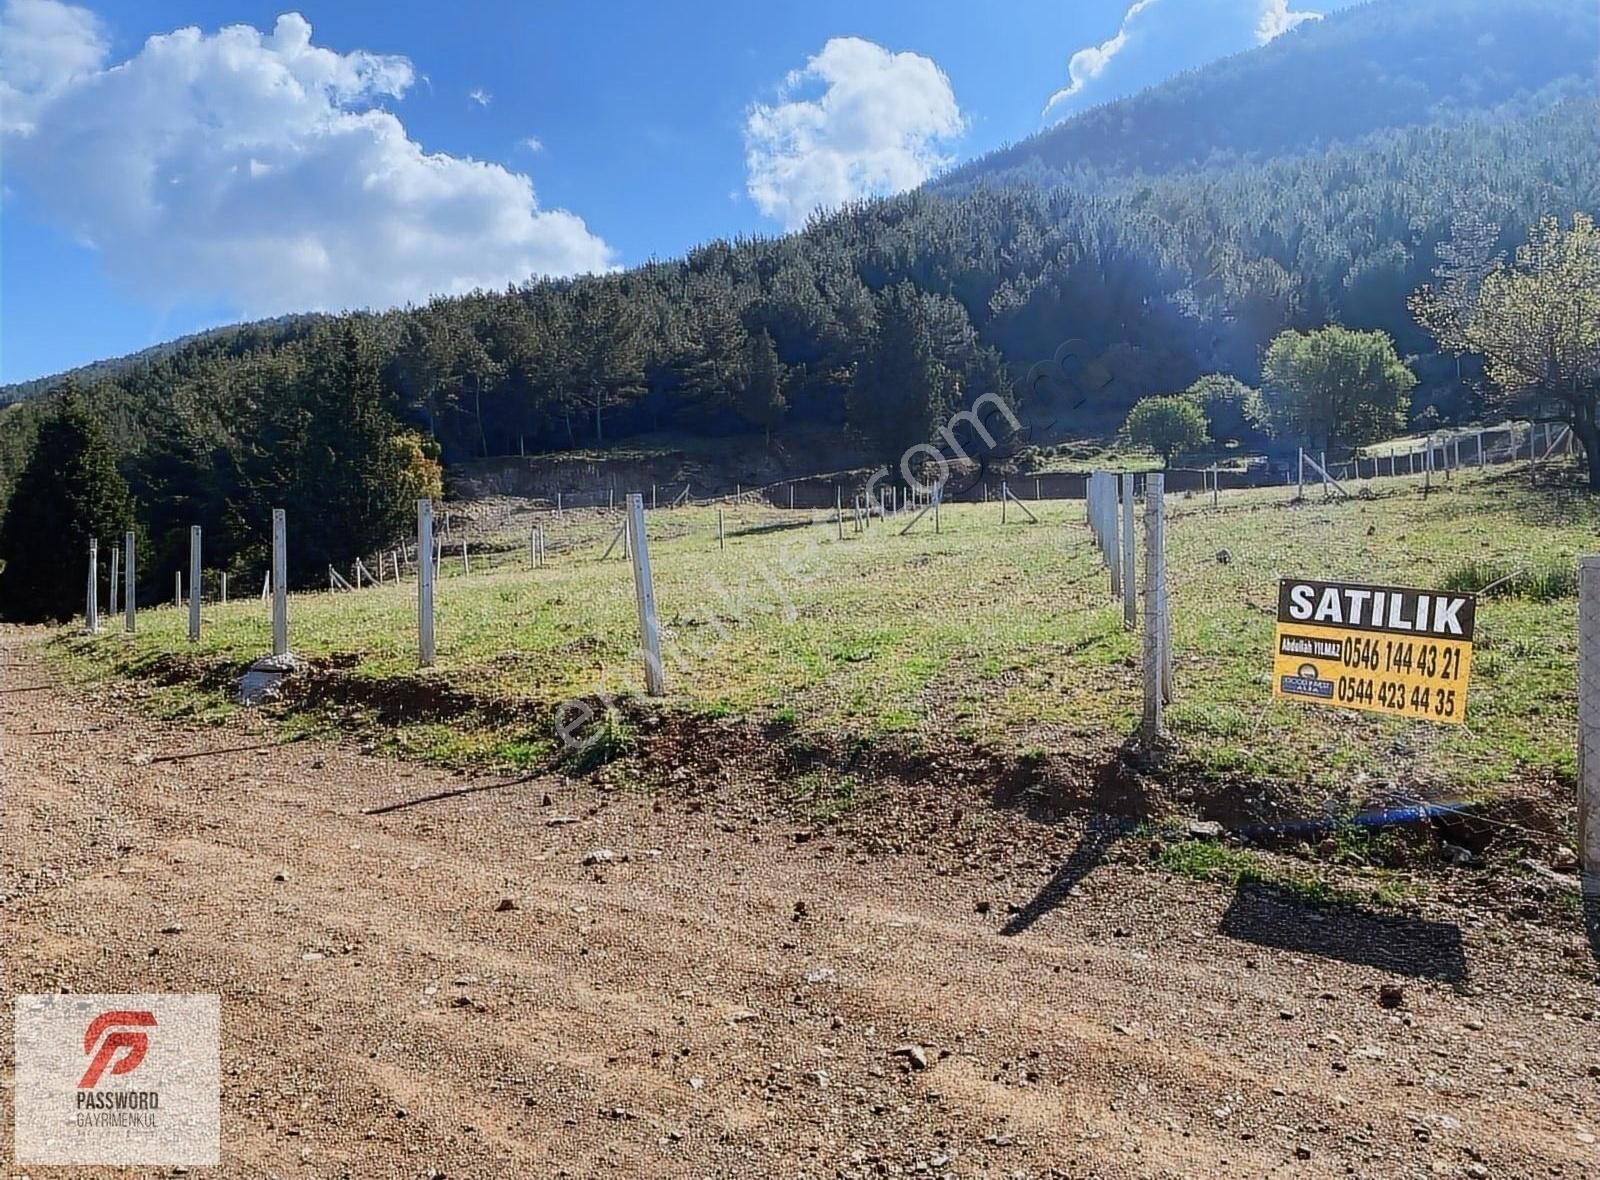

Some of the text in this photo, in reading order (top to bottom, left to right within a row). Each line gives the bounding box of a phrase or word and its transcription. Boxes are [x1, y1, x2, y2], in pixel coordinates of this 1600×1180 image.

[1289, 584, 1466, 635] SATILIK
[1343, 636, 1379, 671] 0546
[1386, 641, 1413, 675] 144
[1416, 645, 1437, 678] 43
[1441, 647, 1461, 680] 21
[1338, 675, 1373, 705] 0544
[1378, 681, 1405, 710] 423
[1410, 685, 1430, 713] 44
[1435, 688, 1455, 717] 35
